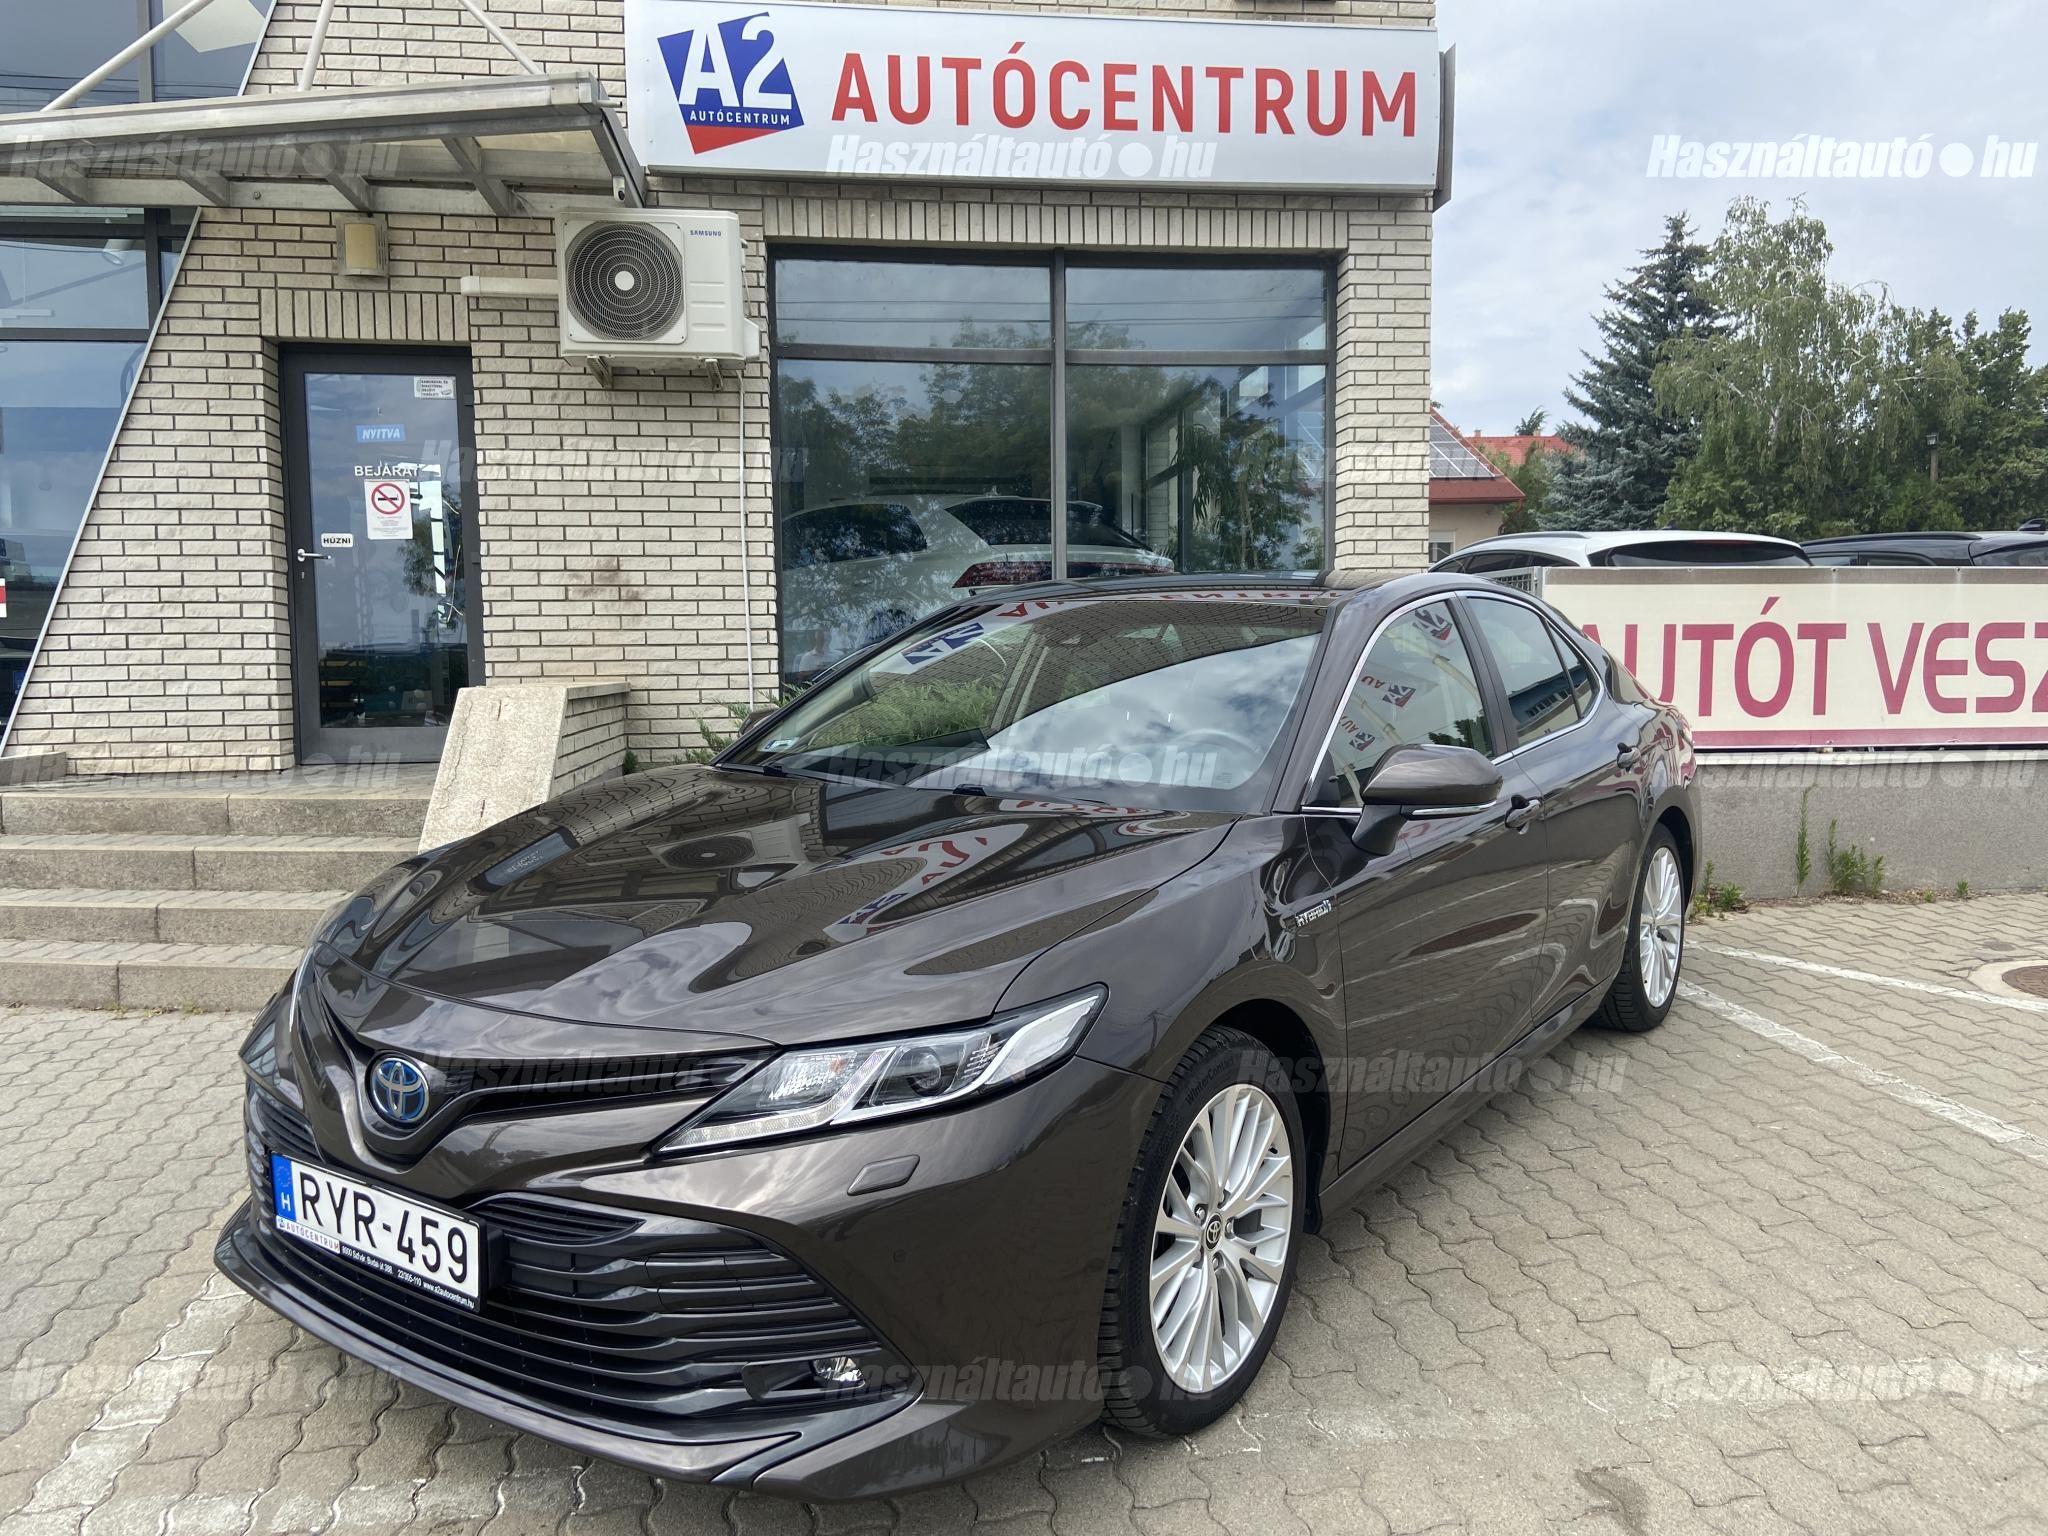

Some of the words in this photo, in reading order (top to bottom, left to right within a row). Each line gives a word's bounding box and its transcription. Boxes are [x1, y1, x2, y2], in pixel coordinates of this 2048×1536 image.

[678, 15, 793, 110] A2
[831, 41, 1417, 138] AUTÓCENTRUM
[689, 109, 791, 126] AUTÓCENTRUM
[690, 229, 722, 237] SAMSUNG
[361, 428, 401, 441] NYITVA
[1581, 597, 1847, 718] UTÓT
[1866, 621, 2048, 714] VES
[280, 1192, 291, 1212] H
[299, 1171, 468, 1284] RYR-459
